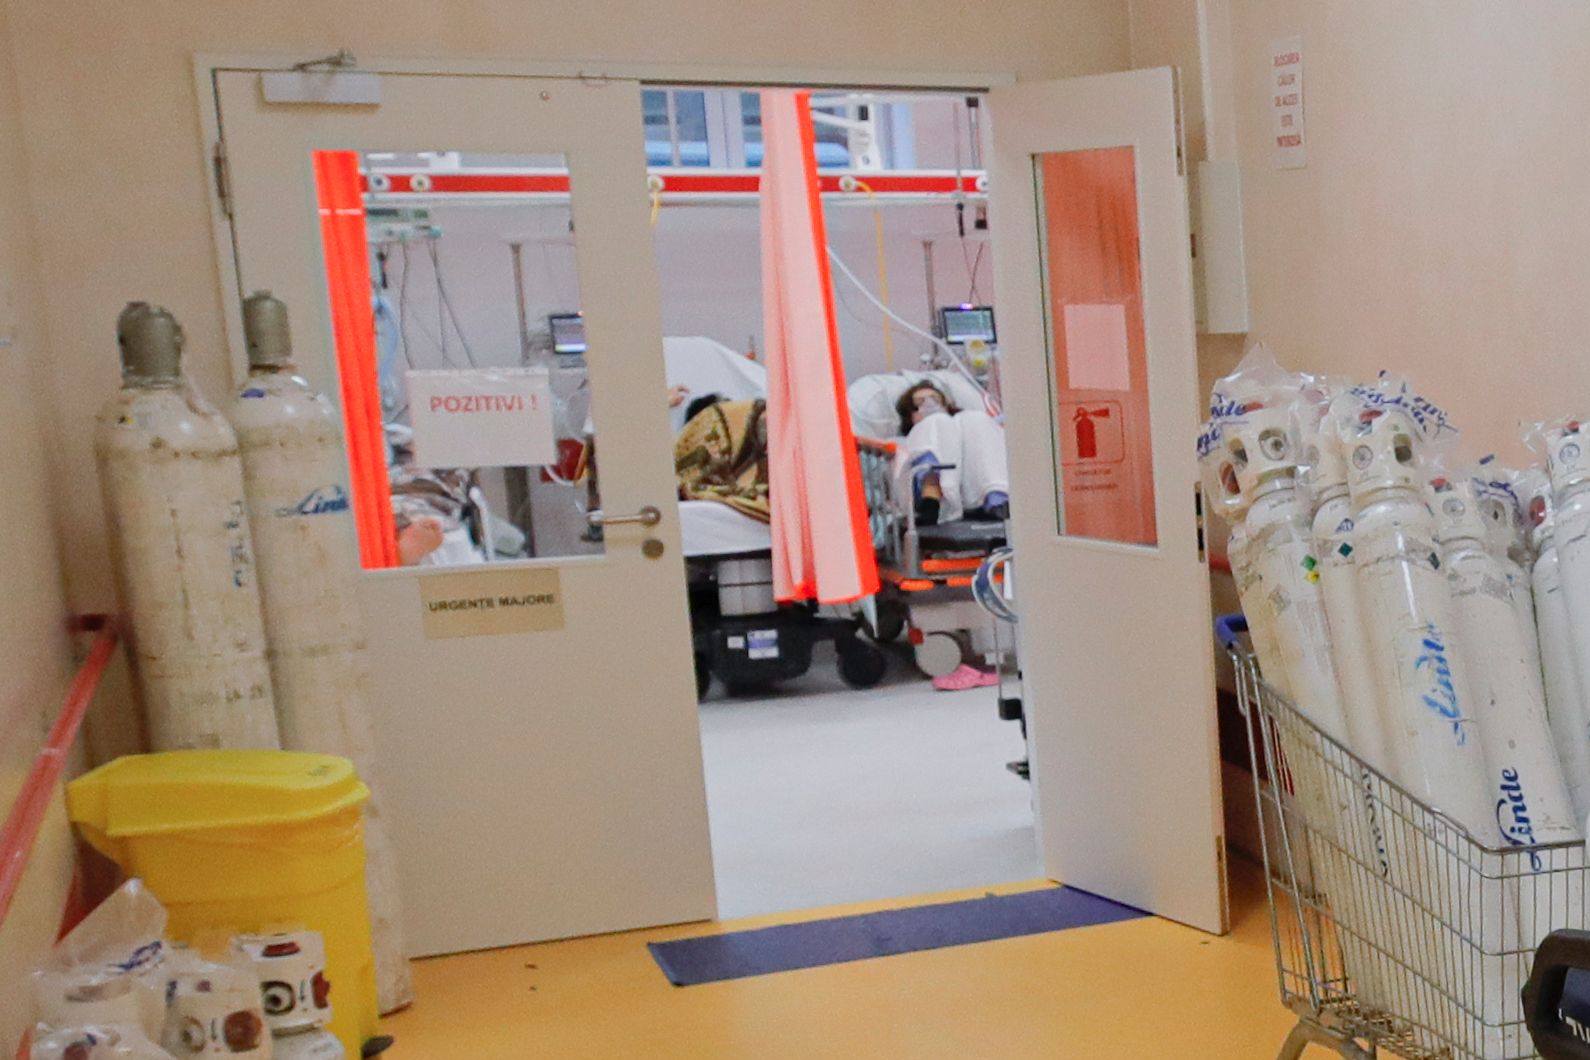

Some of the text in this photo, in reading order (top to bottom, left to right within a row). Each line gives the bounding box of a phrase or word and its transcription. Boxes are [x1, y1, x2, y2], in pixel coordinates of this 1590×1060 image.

[430, 393, 537, 412] POZITIVI !
[498, 593, 555, 608] MAJORE
[1496, 766, 1542, 872] Linde
